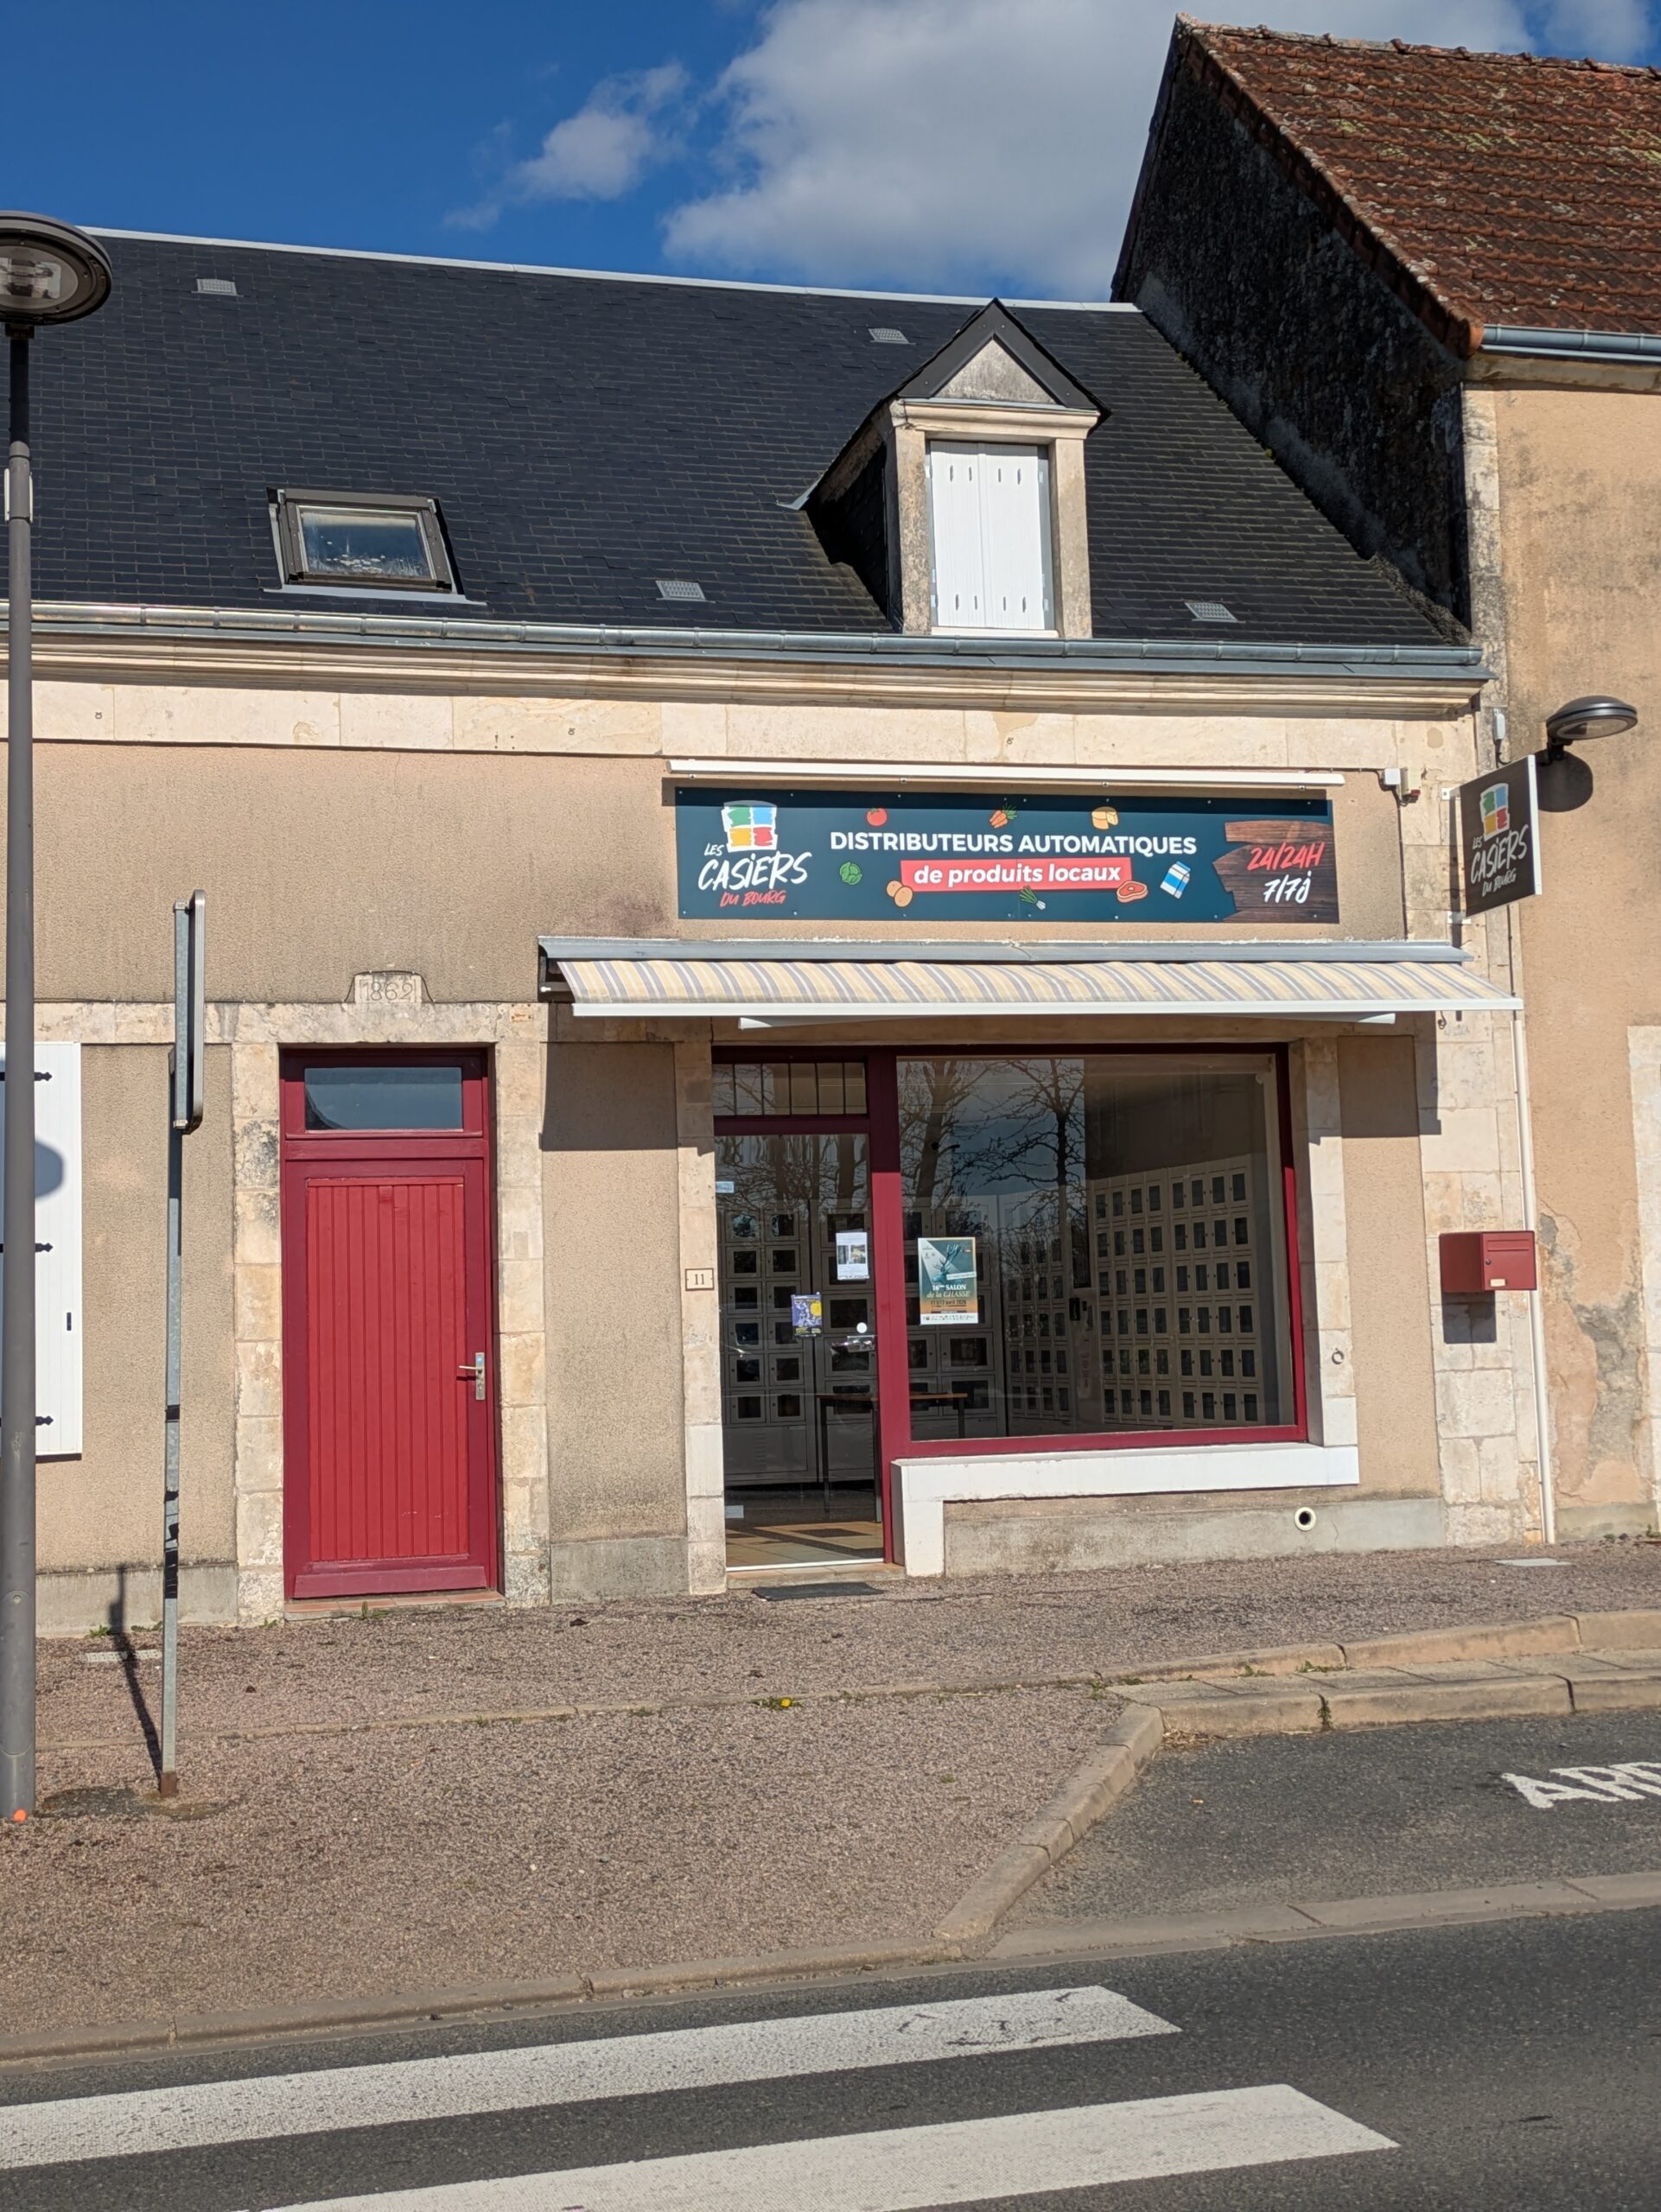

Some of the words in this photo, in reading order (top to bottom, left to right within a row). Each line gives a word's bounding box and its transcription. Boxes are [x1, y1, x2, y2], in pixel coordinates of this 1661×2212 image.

[703, 842, 725, 856] LES
[830, 831, 1014, 853] DISTRIBUTEURS
[1018, 835, 1197, 857] AUTOMATIQUES
[1473, 836, 1483, 849] LES
[1247, 842, 1325, 870] 24/24H
[913, 866, 943, 884] de
[948, 863, 1043, 887] produits
[1048, 864, 1121, 881] locaux
[1263, 870, 1312, 904] 7/7j
[741, 890, 787, 907] BOURG
[363, 982, 413, 1001] 1862
[694, 1274, 704, 1285] 11
